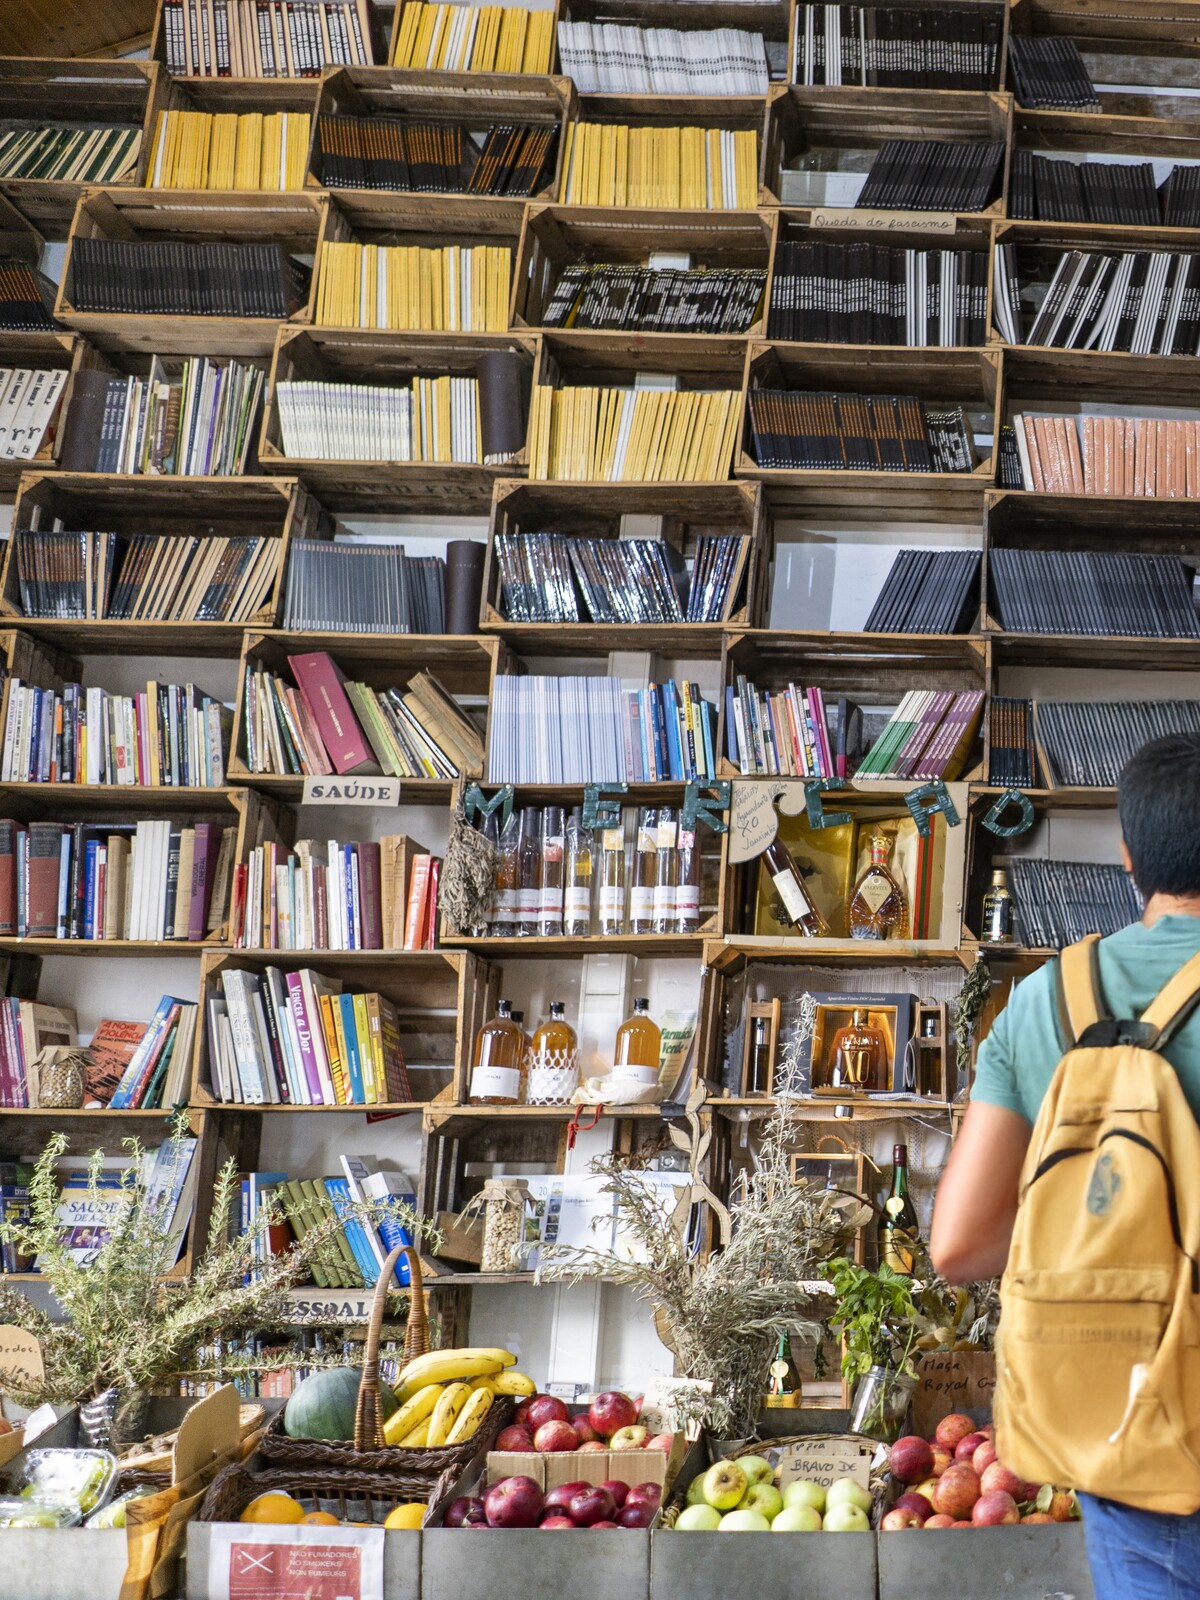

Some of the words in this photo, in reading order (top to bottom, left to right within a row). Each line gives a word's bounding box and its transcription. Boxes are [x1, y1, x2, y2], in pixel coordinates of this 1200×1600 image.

[815, 215, 858, 226] Queda
[866, 218, 885, 226] do
[888, 219, 952, 230] fascismo
[311, 780, 390, 800] SAÚDE
[737, 816, 758, 838] XO
[290, 985, 304, 1017] VENCER
[143, 1012, 165, 1045] FORMA
[296, 1018, 306, 1028] a
[98, 1029, 144, 1040] VIOLÊNCIA
[298, 1029, 312, 1055] Dor
[841, 1050, 870, 1082] XO
[73, 1214, 88, 1222] DE
[282, 1301, 369, 1317] ESSOAL
[925, 1377, 969, 1394] Royal
[790, 1458, 833, 1472] BRAVO
[838, 1460, 857, 1472] DE
